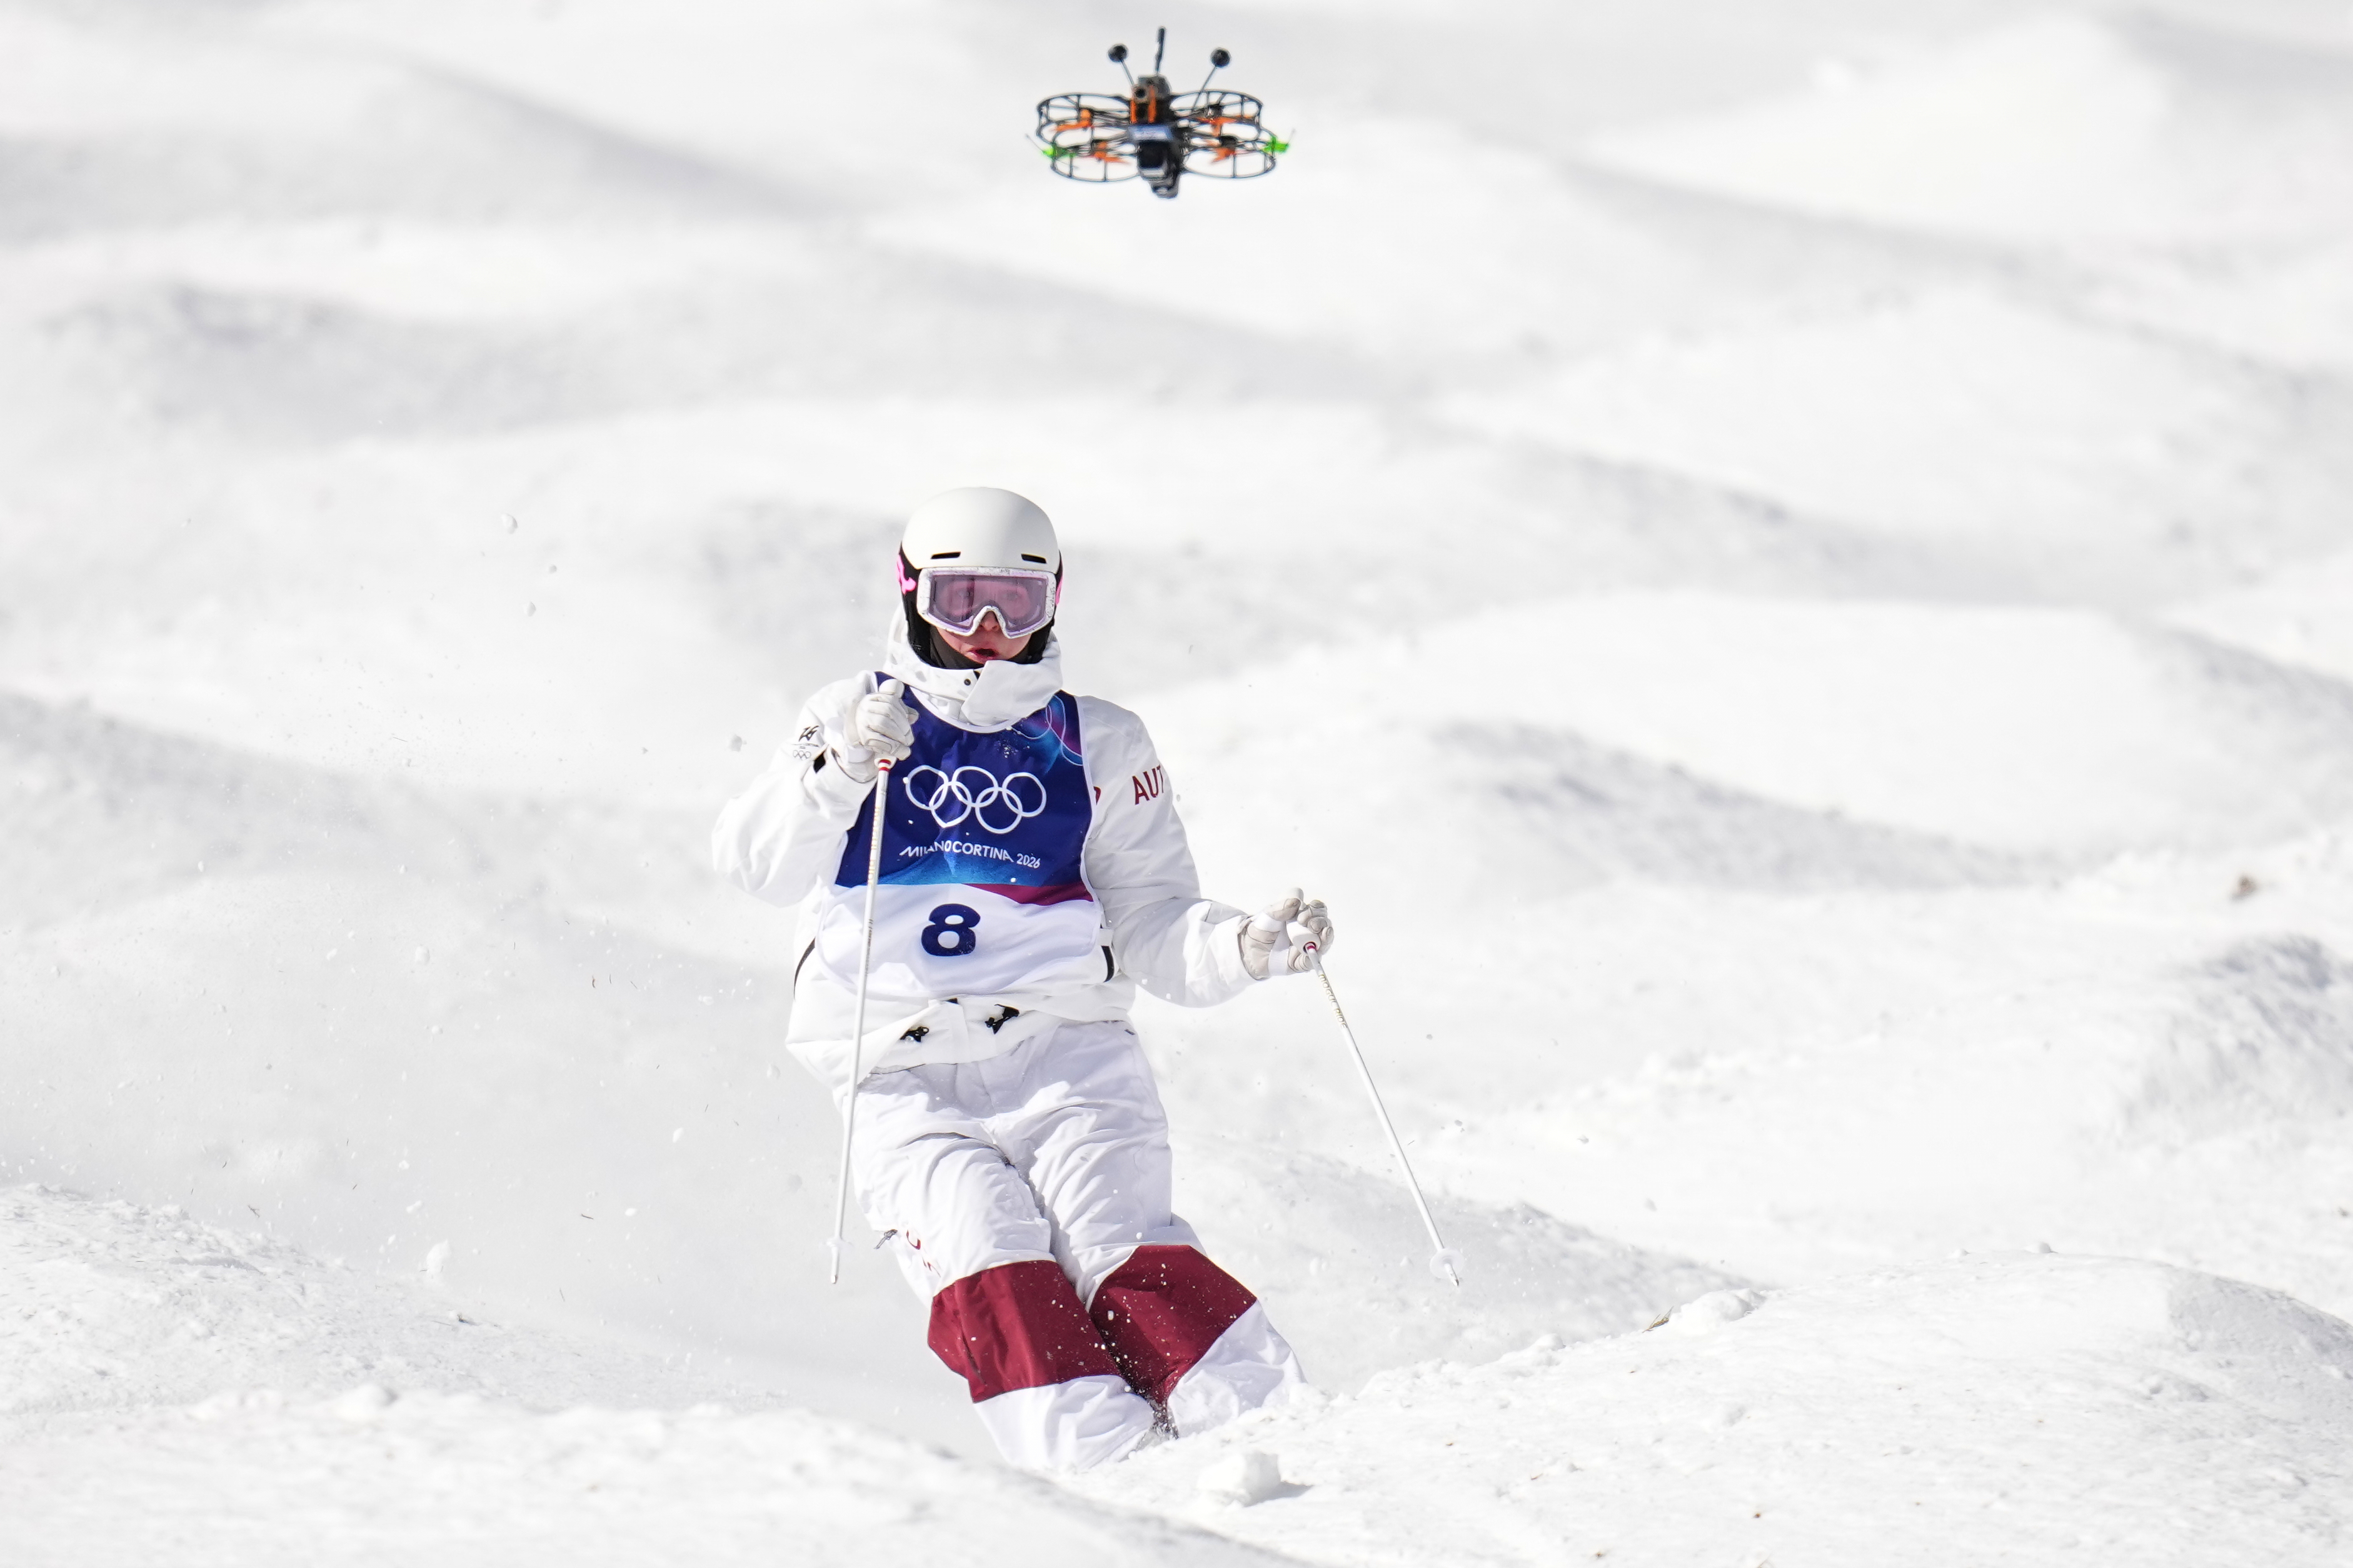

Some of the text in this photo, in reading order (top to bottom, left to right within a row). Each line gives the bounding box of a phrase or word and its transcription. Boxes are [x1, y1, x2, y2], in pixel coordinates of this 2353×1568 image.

[1132, 765, 1164, 805] AUT
[1016, 853, 1041, 869] 2026
[921, 903, 981, 956] 8
